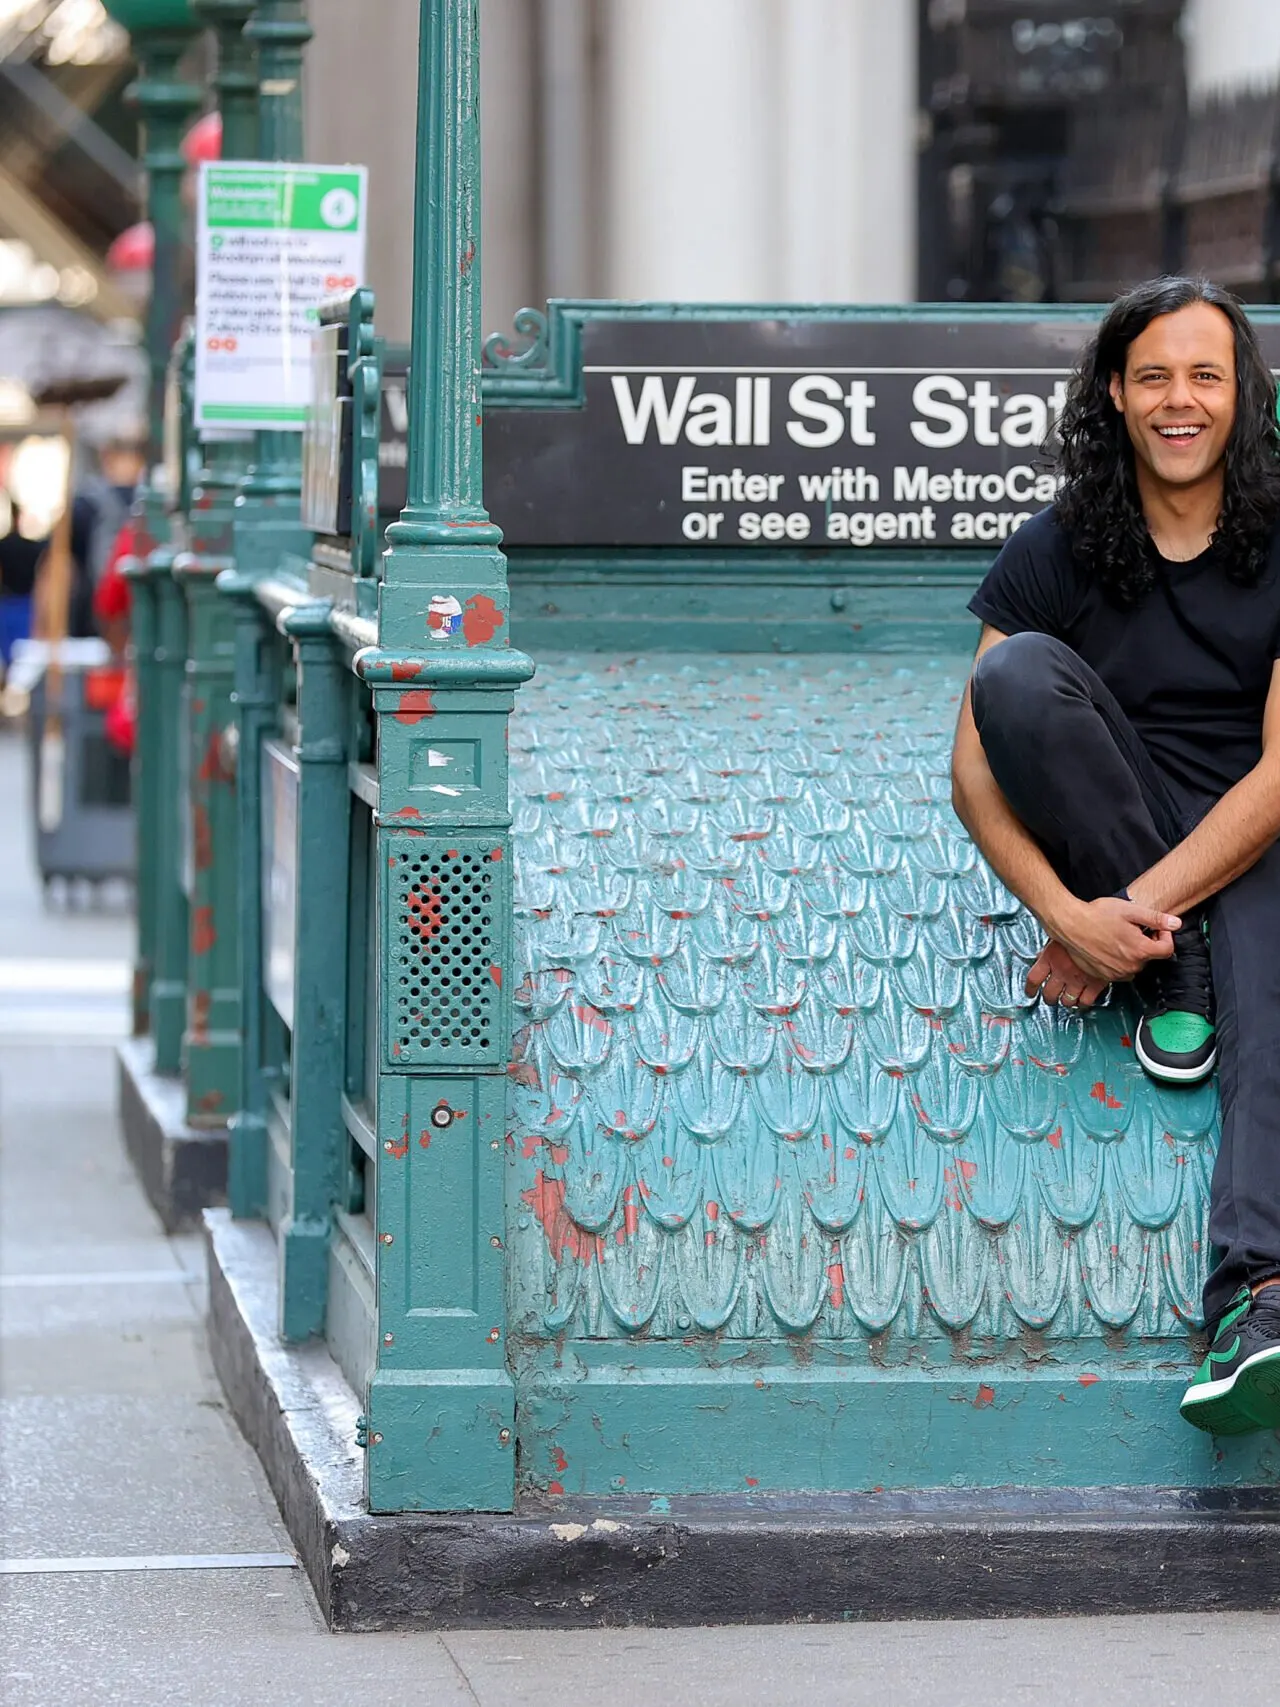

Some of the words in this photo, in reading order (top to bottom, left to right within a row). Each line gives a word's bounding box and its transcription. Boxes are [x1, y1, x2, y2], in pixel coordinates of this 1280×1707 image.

[611, 375, 771, 446] Wall
[786, 375, 876, 448] St
[910, 375, 1070, 448] Stat
[682, 466, 785, 502] Enter
[798, 466, 879, 502] with
[893, 465, 1066, 503] MetroCa
[682, 511, 724, 540] or
[738, 511, 811, 541] see
[826, 506, 936, 546] agent
